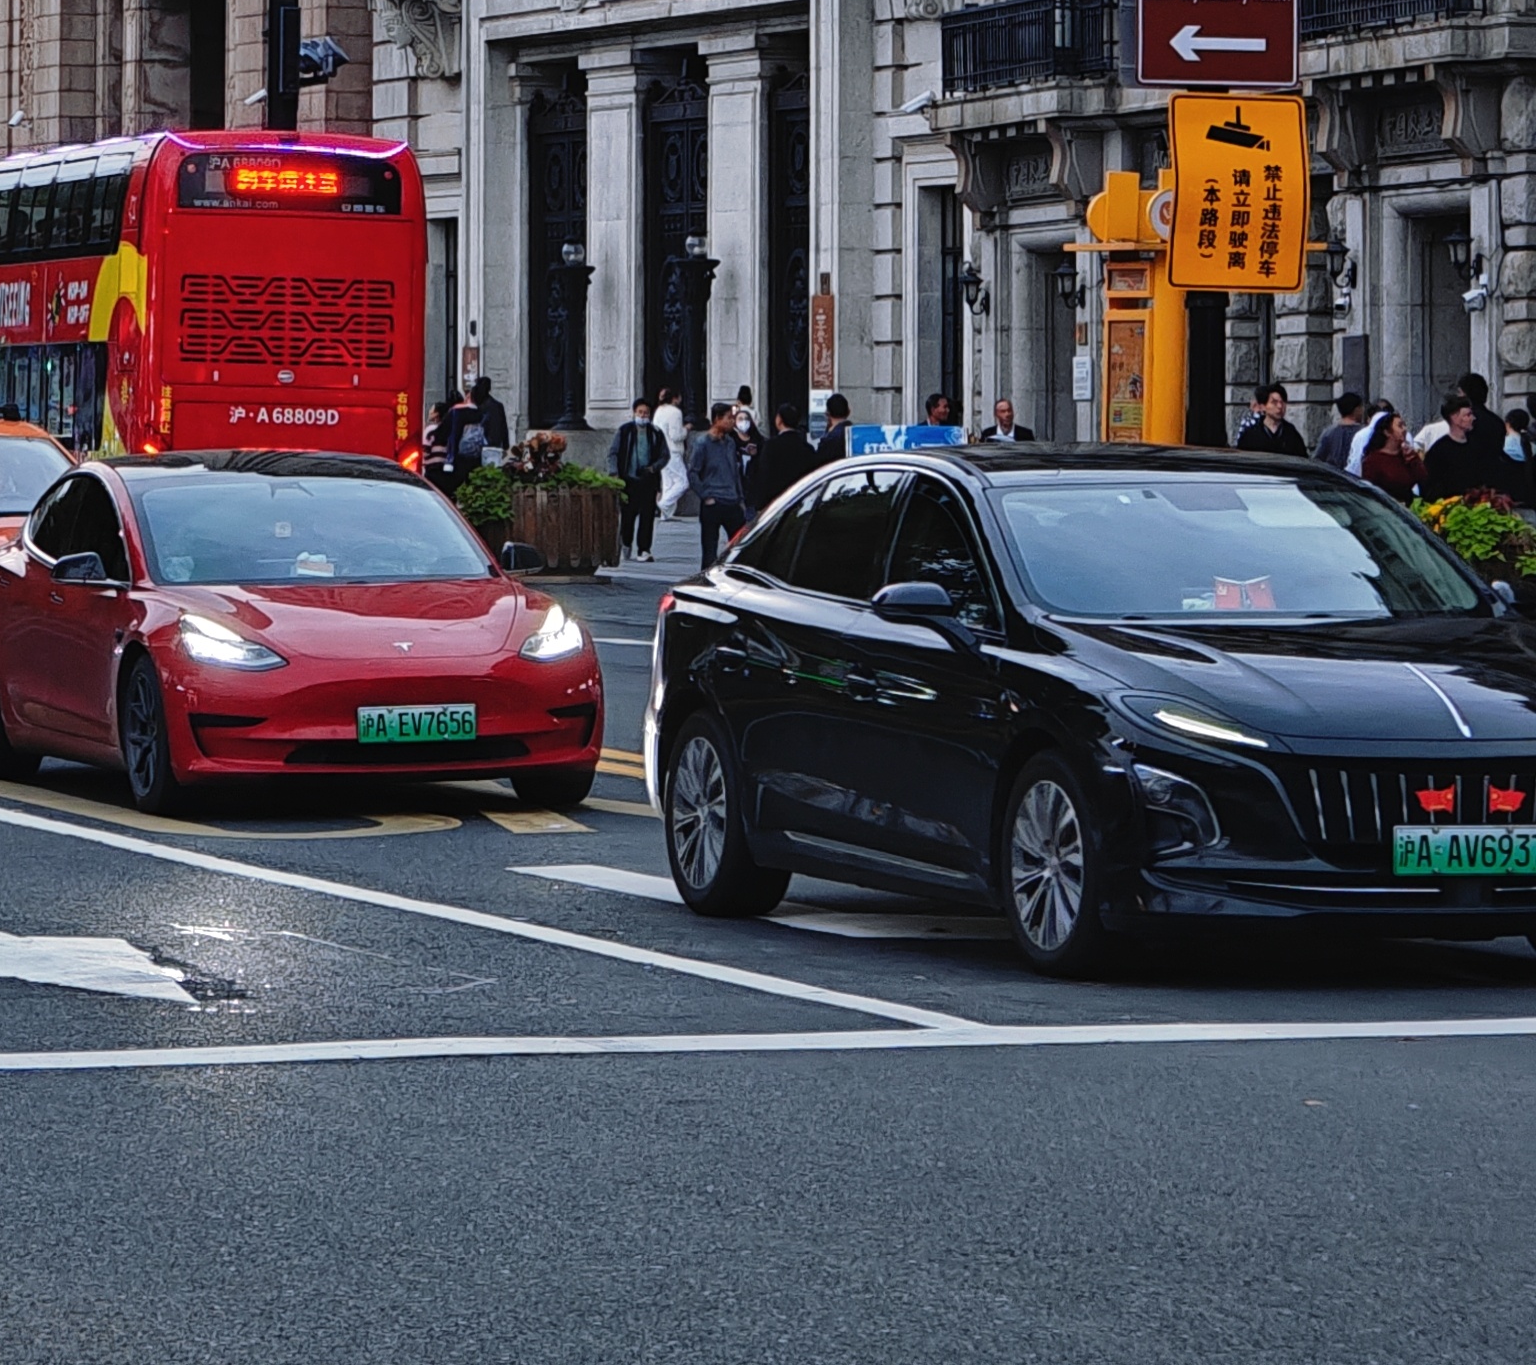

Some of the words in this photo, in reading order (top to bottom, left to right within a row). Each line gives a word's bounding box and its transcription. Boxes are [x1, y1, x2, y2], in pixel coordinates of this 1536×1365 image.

[1227, 168, 1252, 270] 请立即驶离
[1256, 164, 1284, 279] 禁止违法停车
[272, 408, 340, 426] 68809D
[398, 710, 474, 737] EV7656
[1398, 834, 1432, 868] 沪A
[1447, 834, 1536, 868] AV693
